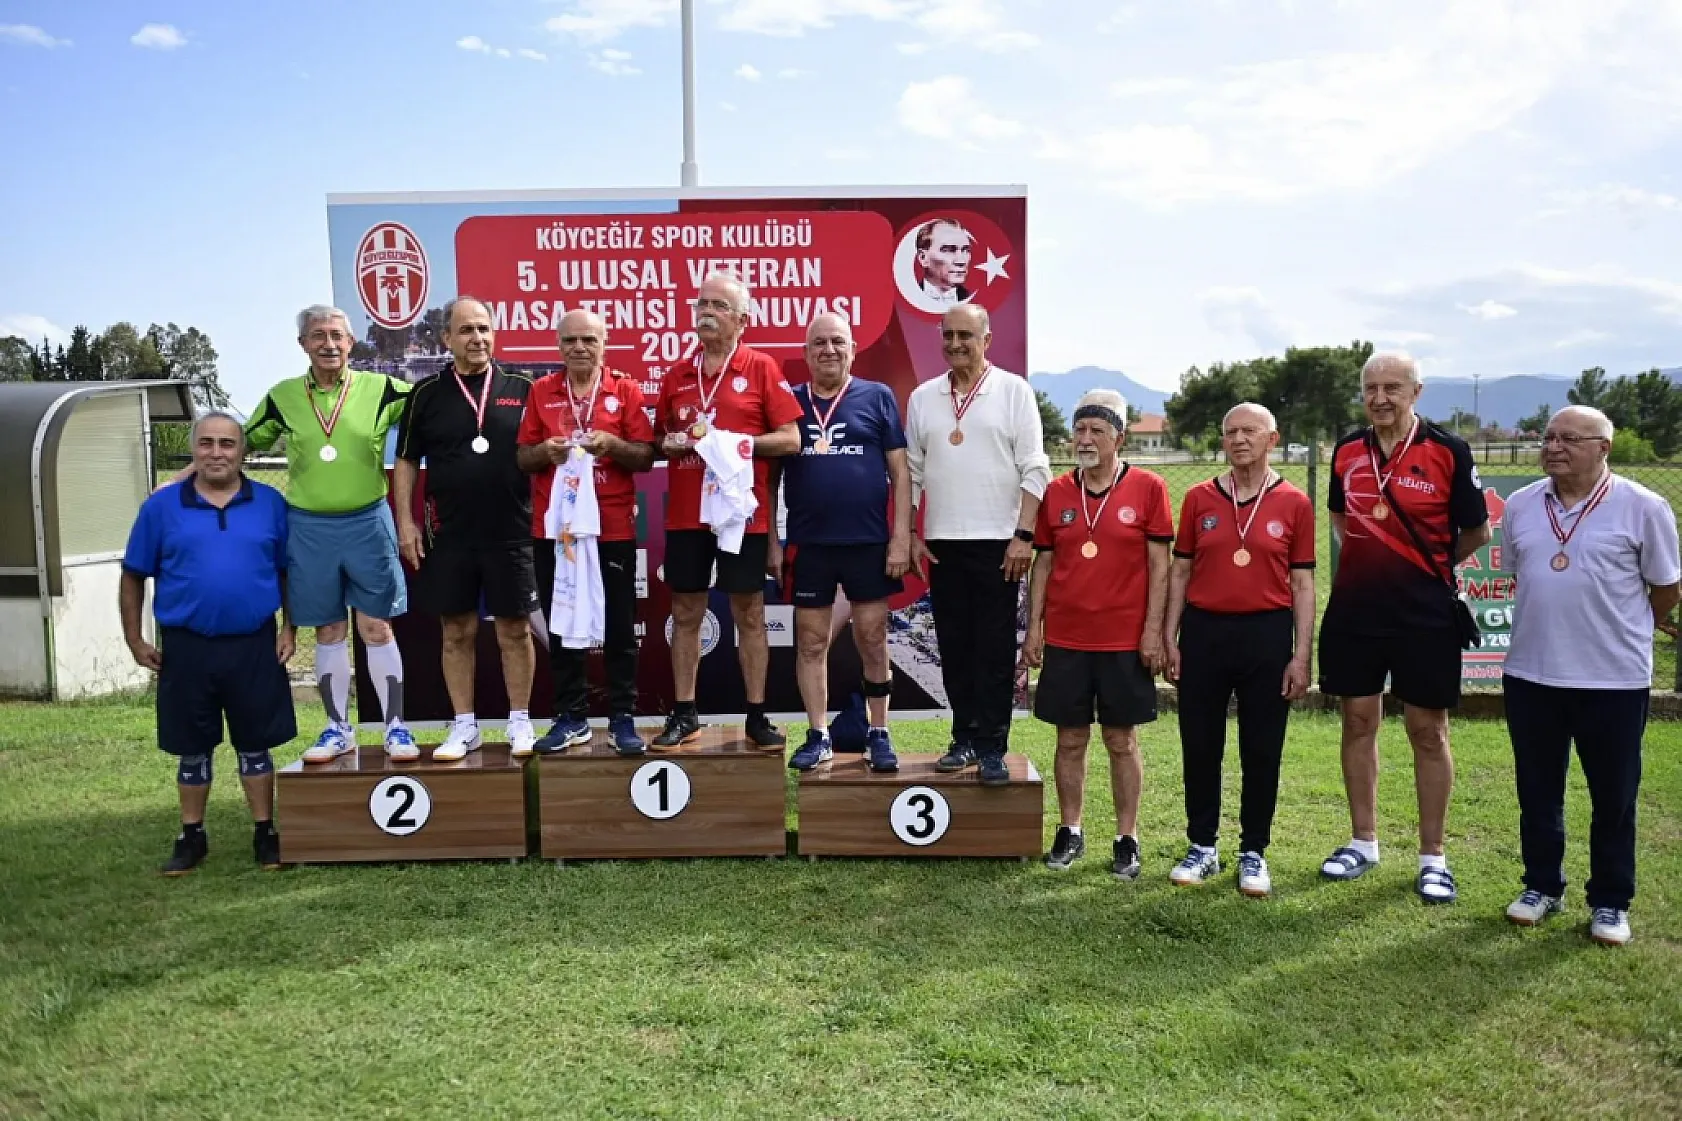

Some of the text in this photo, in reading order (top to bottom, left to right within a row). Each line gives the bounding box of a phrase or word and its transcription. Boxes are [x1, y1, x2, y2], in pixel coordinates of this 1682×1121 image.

[536, 219, 812, 250] KÖYCEĞİZ SPOR KULÜBÜ
[517, 260, 549, 292] 5.
[559, 259, 677, 290] ULUSAL
[641, 331, 700, 361] 202
[386, 783, 416, 828] 2
[648, 767, 668, 811] 1
[906, 794, 935, 838] 3
